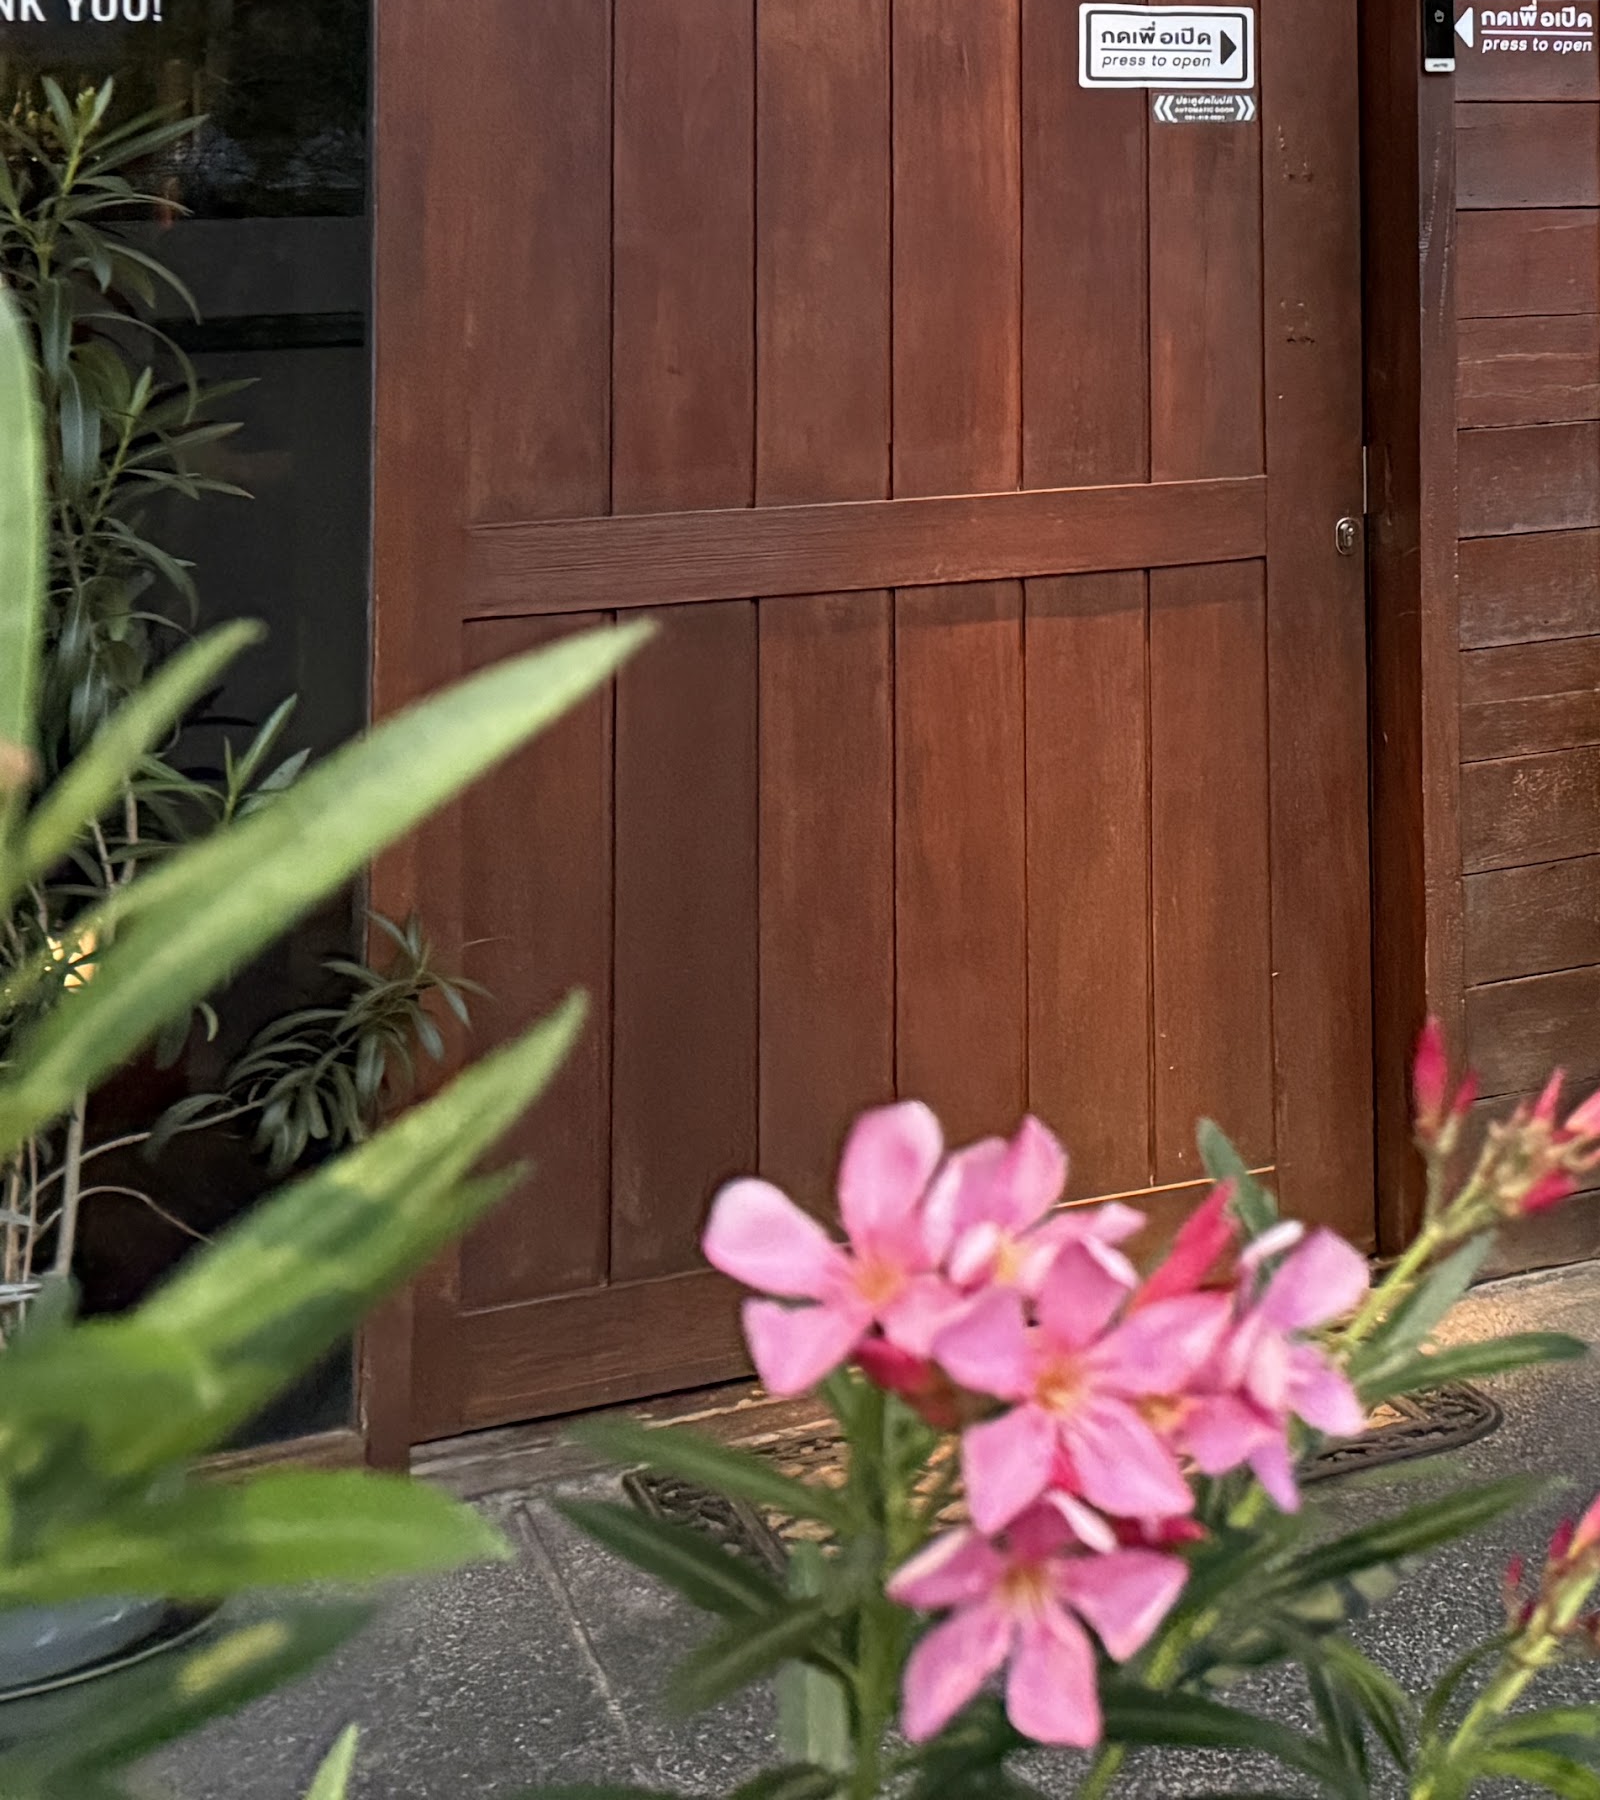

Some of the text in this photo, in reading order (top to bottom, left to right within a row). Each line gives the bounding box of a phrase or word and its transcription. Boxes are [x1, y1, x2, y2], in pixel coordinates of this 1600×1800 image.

[1101, 21, 1212, 45] กดเพื่อเปิด
[1482, 38, 1592, 54] press to open
[1102, 55, 1211, 69] press to open
